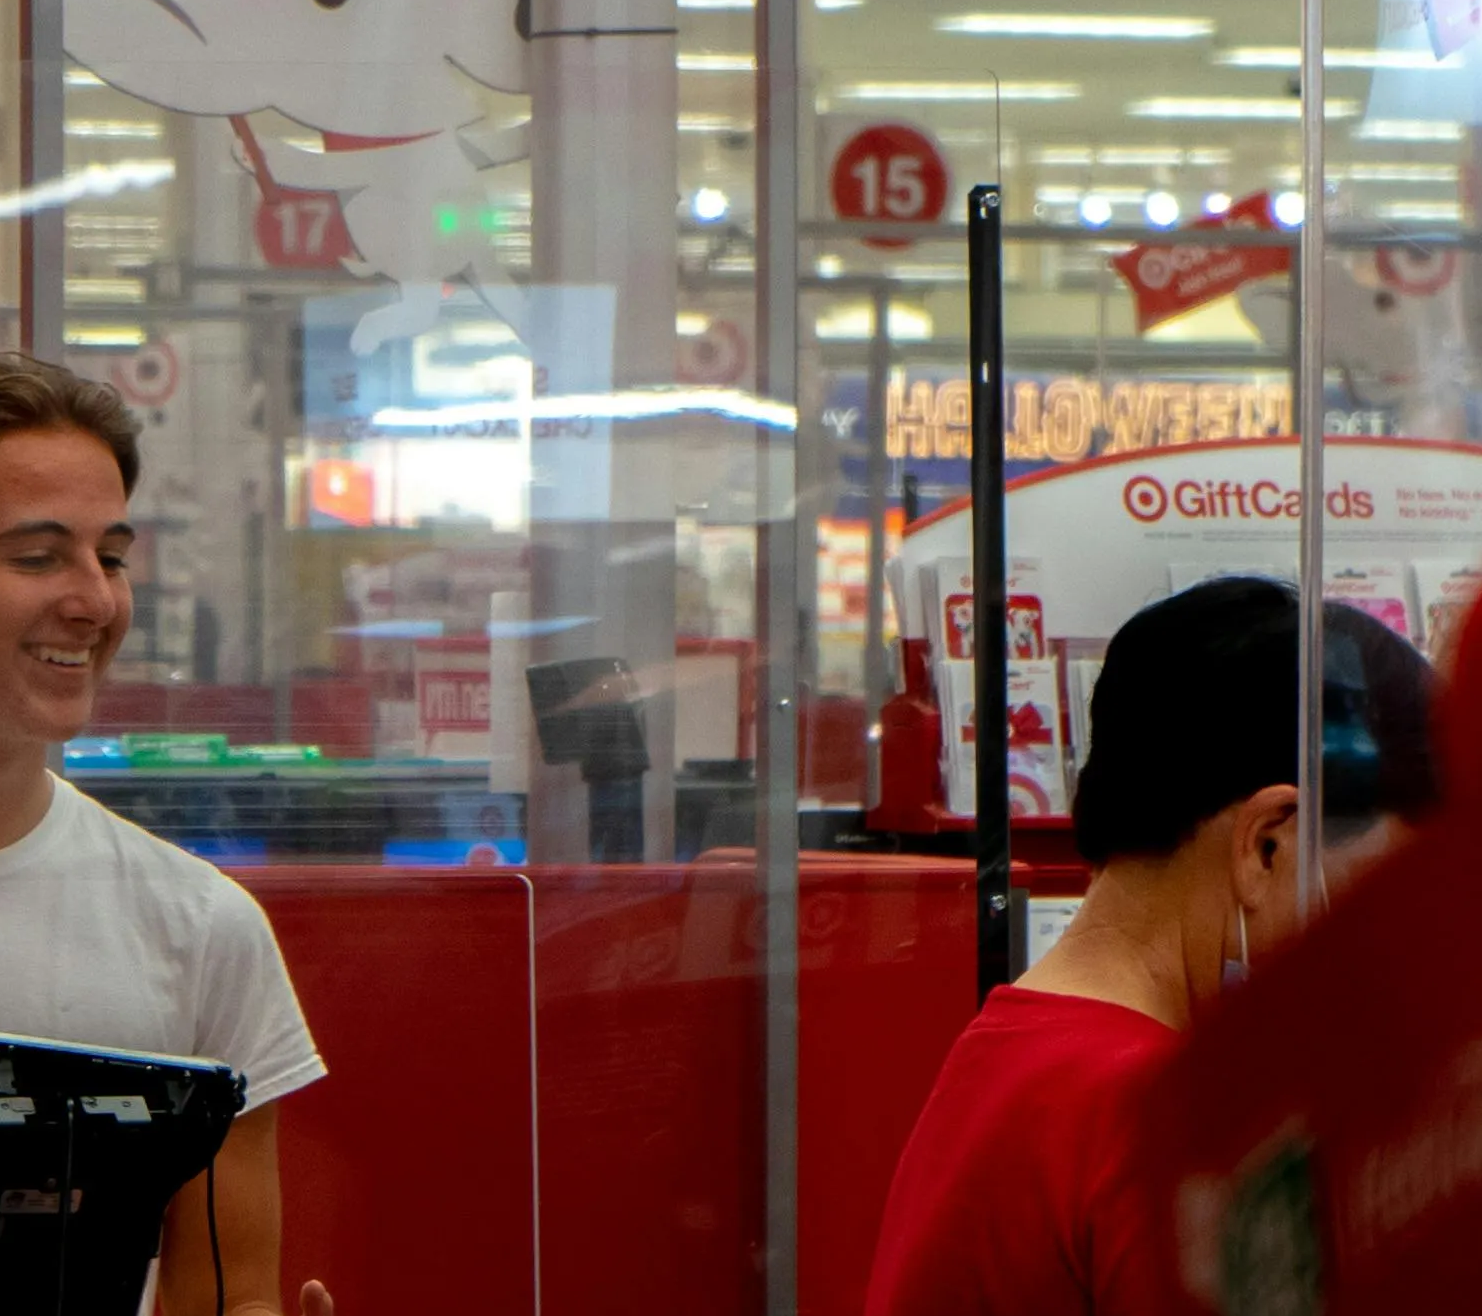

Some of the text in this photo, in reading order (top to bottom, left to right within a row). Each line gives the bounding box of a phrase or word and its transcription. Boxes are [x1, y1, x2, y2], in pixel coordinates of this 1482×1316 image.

[854, 156, 925, 218] 15
[271, 202, 330, 258] 17
[1173, 480, 1376, 520] GiftCads
